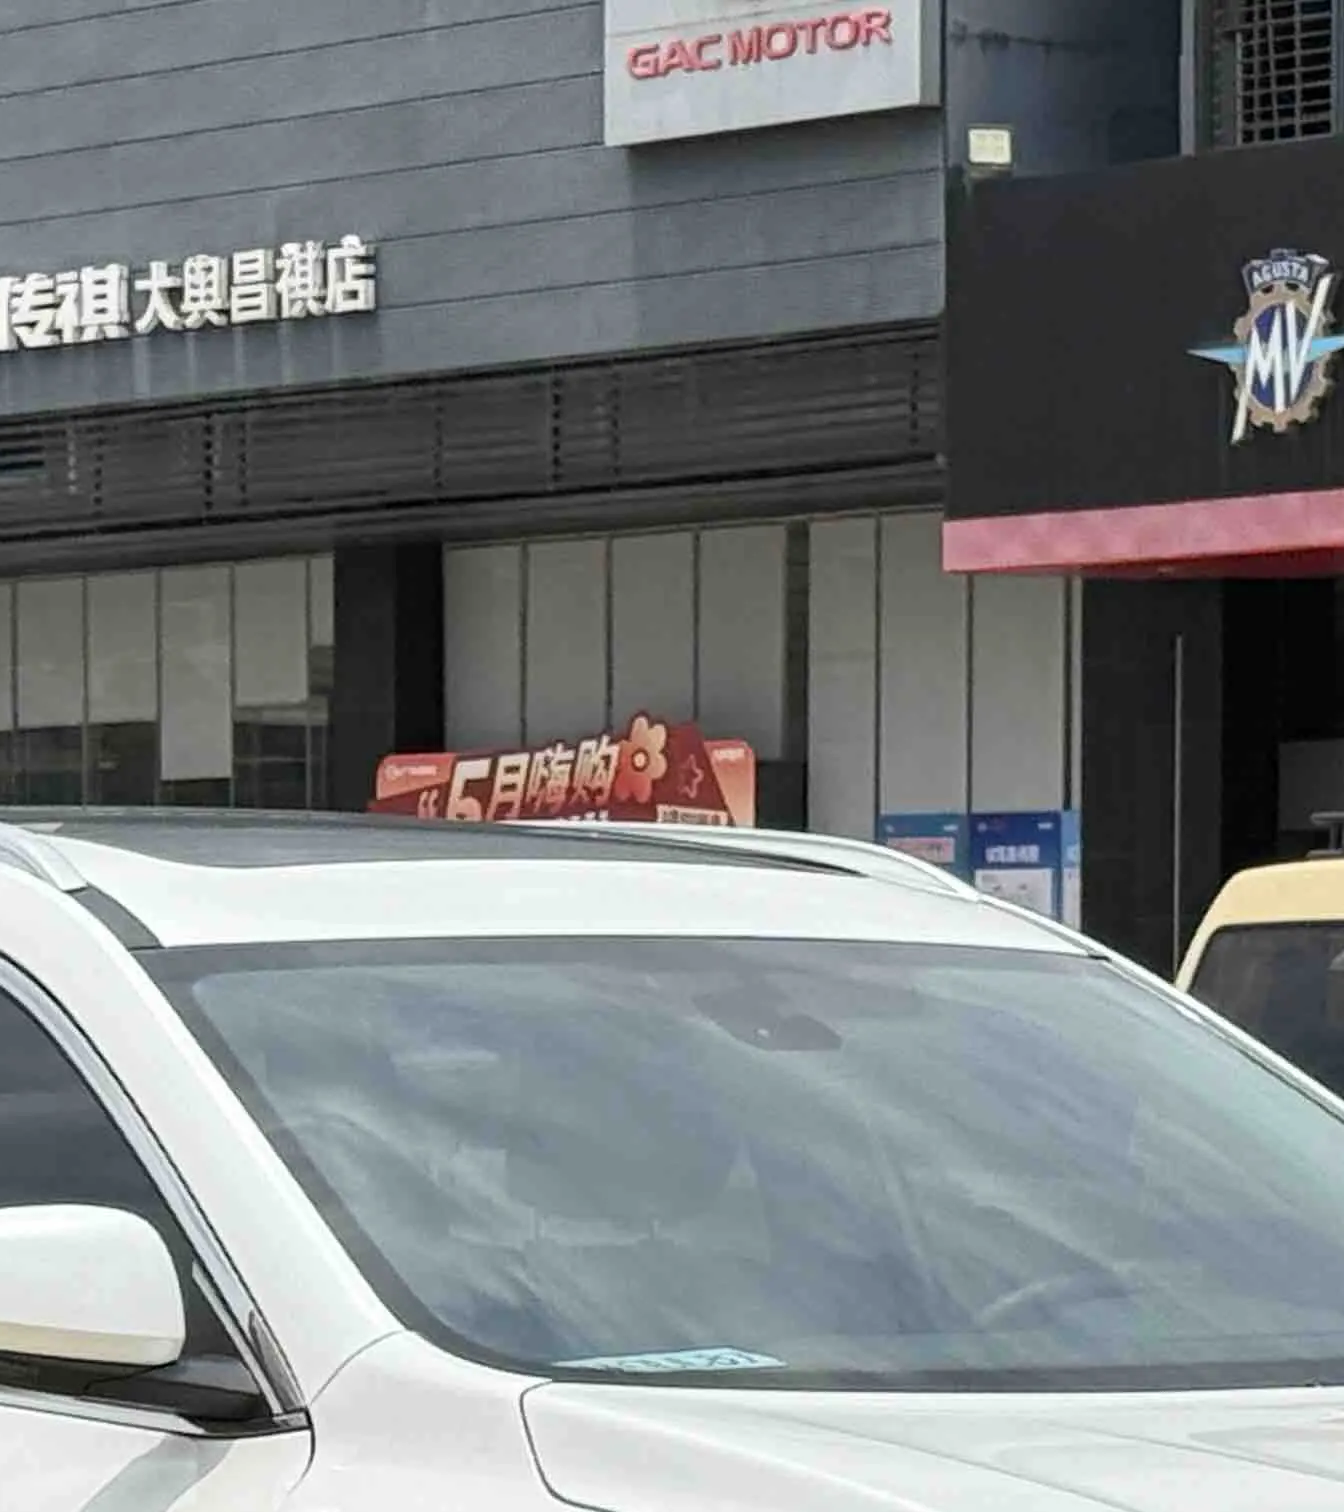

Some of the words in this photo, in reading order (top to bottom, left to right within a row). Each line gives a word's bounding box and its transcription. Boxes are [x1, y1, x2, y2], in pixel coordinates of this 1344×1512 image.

[626, 33, 722, 81] GAC
[728, 8, 893, 67] MOTOR
[1250, 259, 1309, 285] AGUSTA
